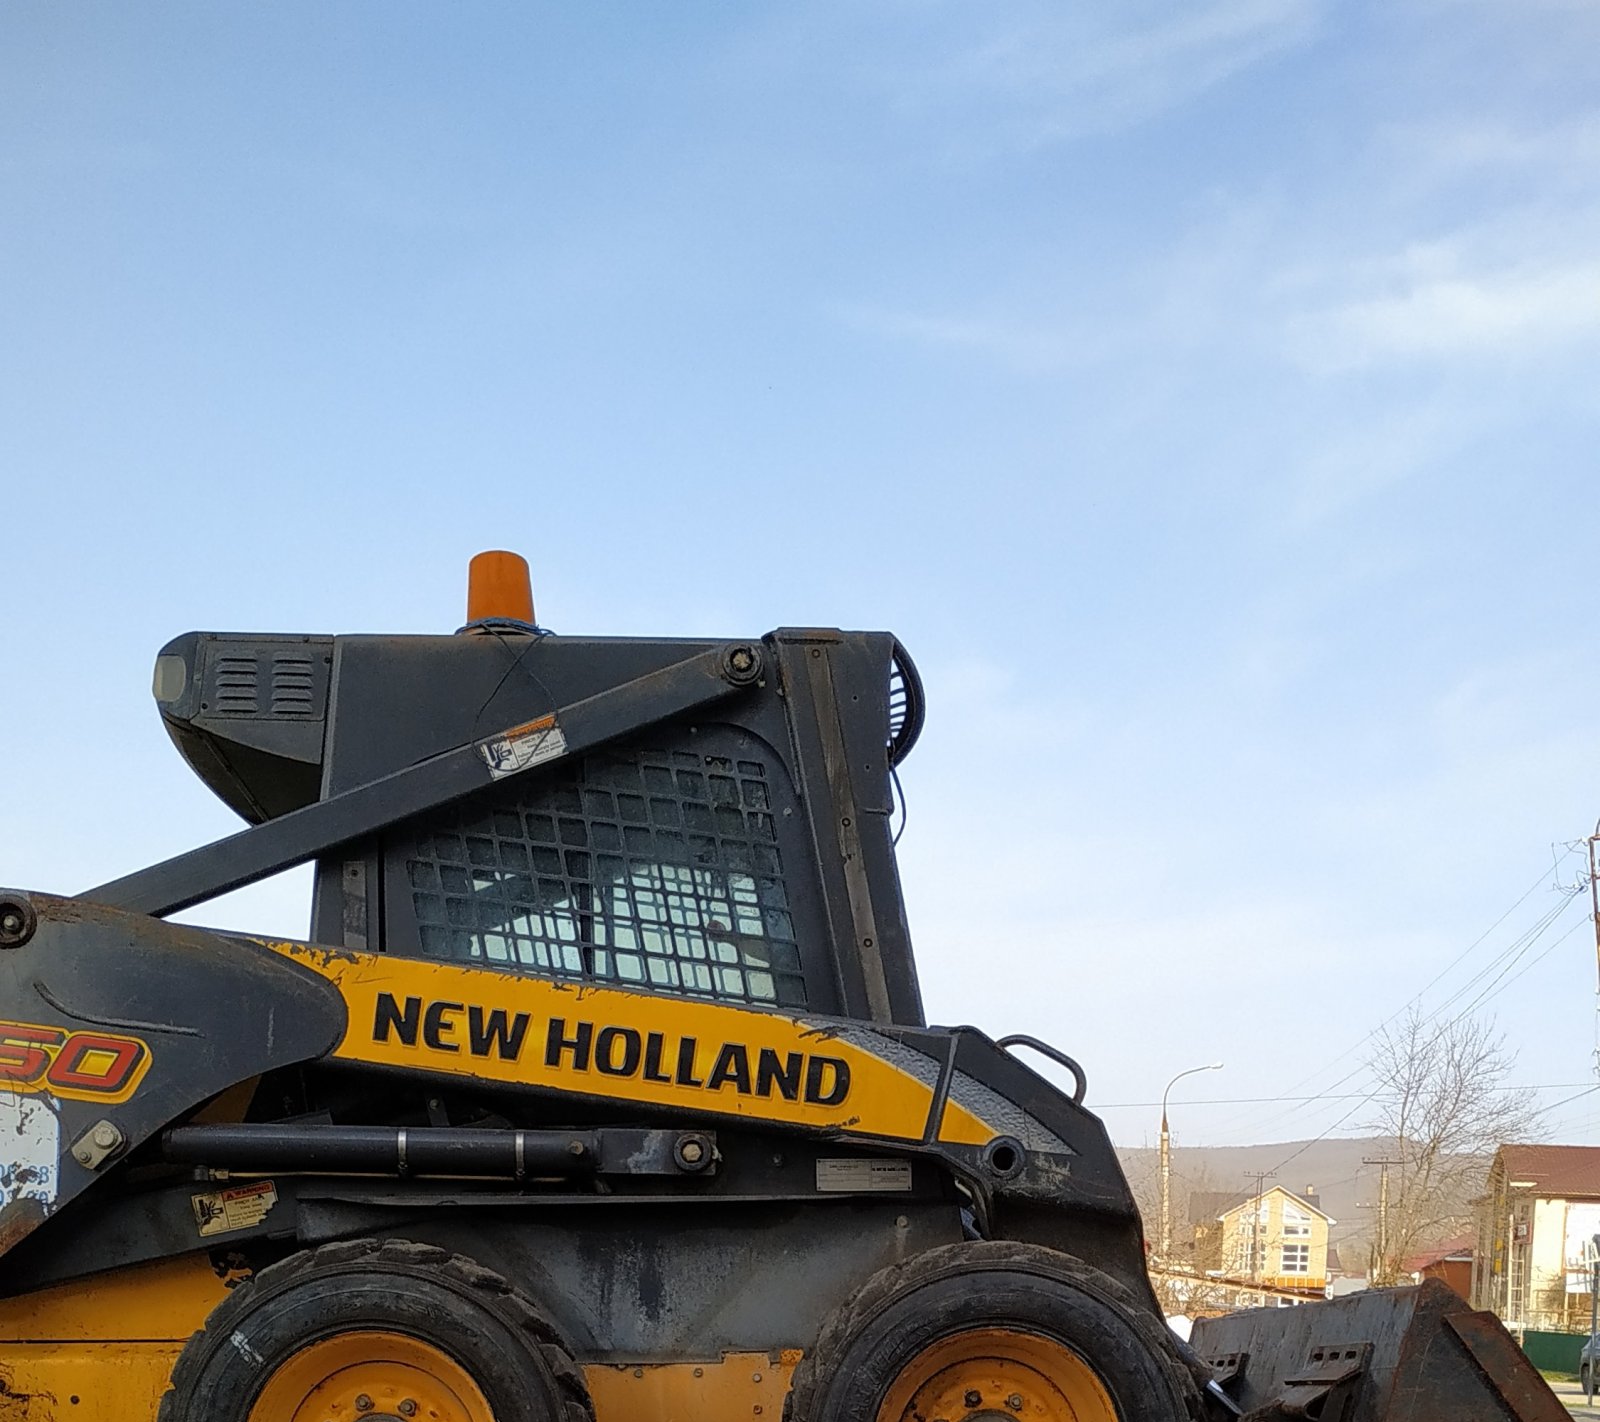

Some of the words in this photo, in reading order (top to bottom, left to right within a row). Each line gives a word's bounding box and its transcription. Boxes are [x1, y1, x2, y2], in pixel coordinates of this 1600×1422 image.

[0, 1023, 149, 1098] 50
[372, 992, 531, 1062] NEW
[544, 1017, 851, 1107] HOLLAND
